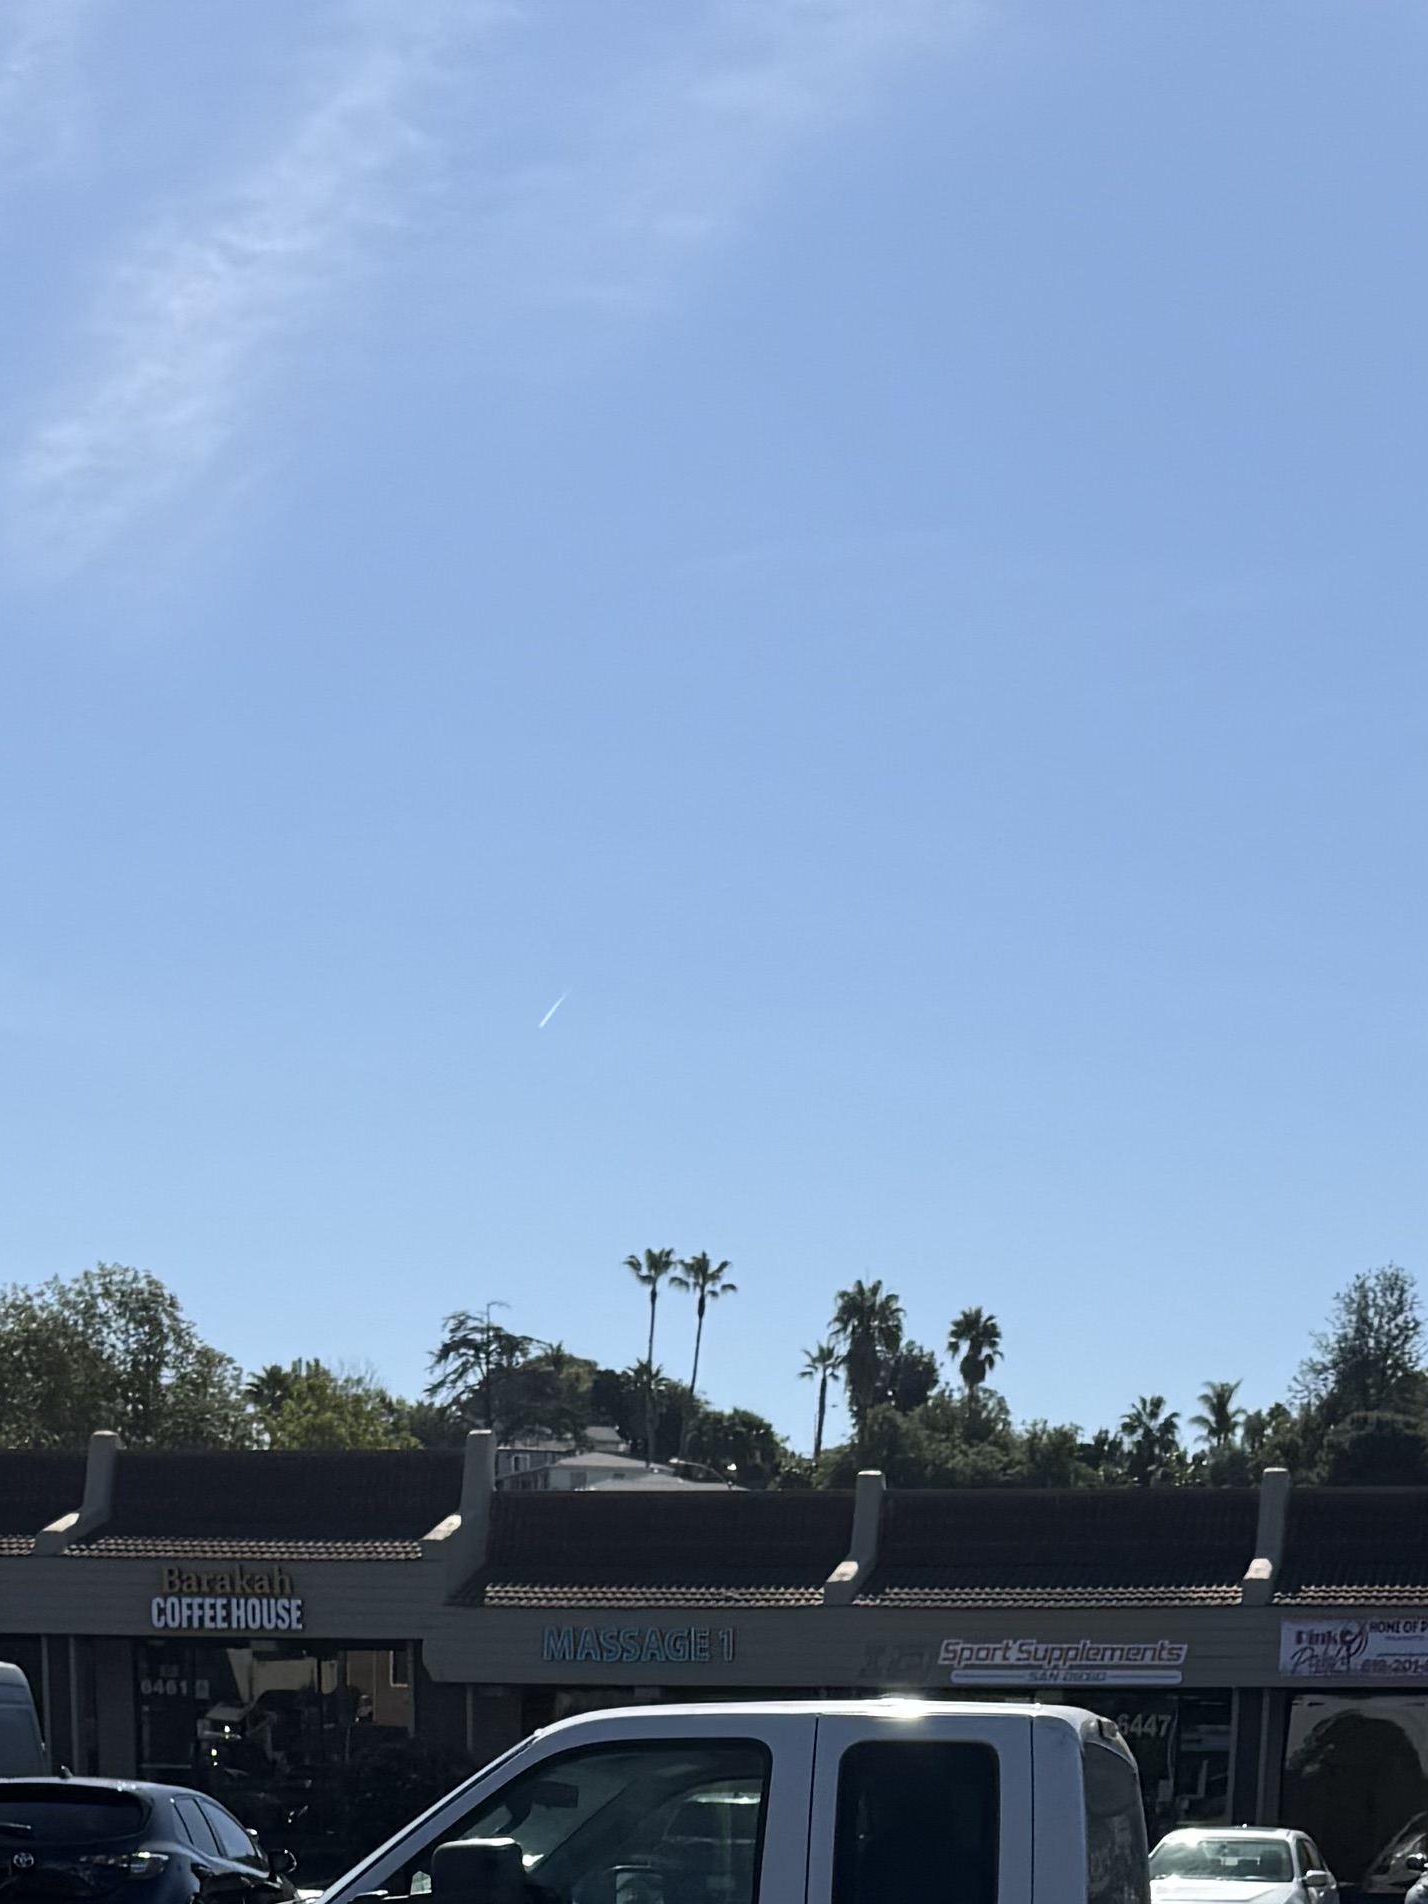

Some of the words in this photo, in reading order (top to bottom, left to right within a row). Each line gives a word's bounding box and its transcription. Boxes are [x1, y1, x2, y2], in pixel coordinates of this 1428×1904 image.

[161, 1564, 293, 1595] Barakah
[151, 1596, 228, 1629] COFFEE
[231, 1597, 303, 1631] HOUSE
[1369, 1621, 1400, 1634] HOME
[1403, 1621, 1417, 1633] OF
[543, 1626, 710, 1662] MASSAGE
[718, 1627, 734, 1661] 1
[938, 1639, 1014, 1667] Sport
[1015, 1639, 1188, 1669] Supplements
